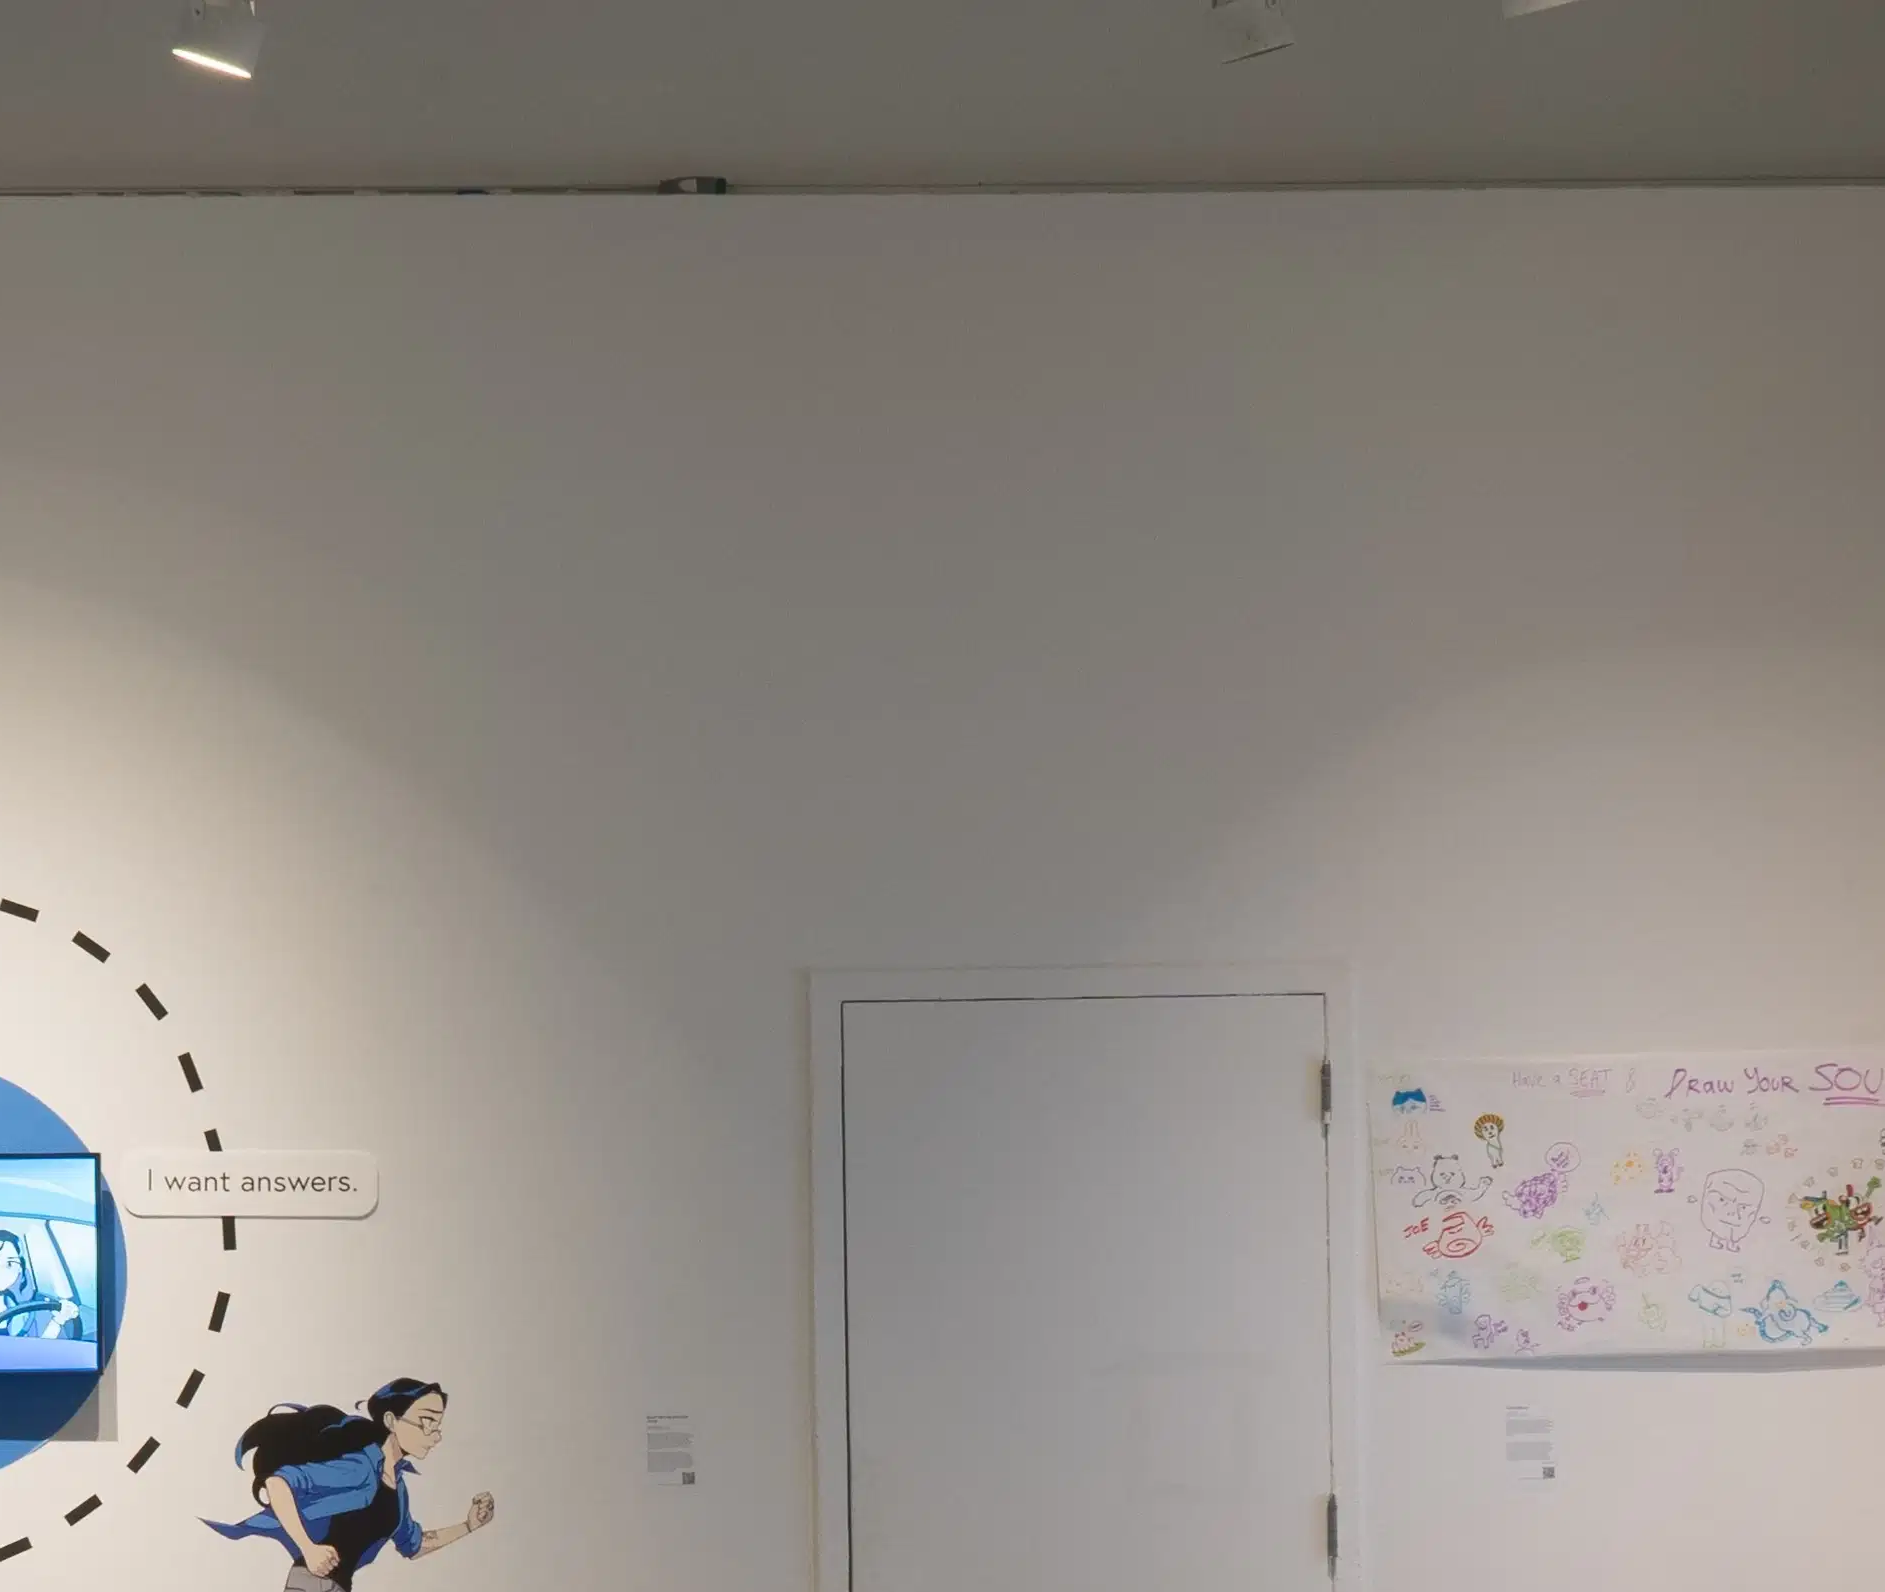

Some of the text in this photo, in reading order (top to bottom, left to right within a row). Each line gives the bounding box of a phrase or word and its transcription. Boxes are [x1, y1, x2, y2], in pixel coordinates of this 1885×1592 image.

[1568, 1067, 1614, 1089] SEAT
[146, 1168, 360, 1194] I want answers.
